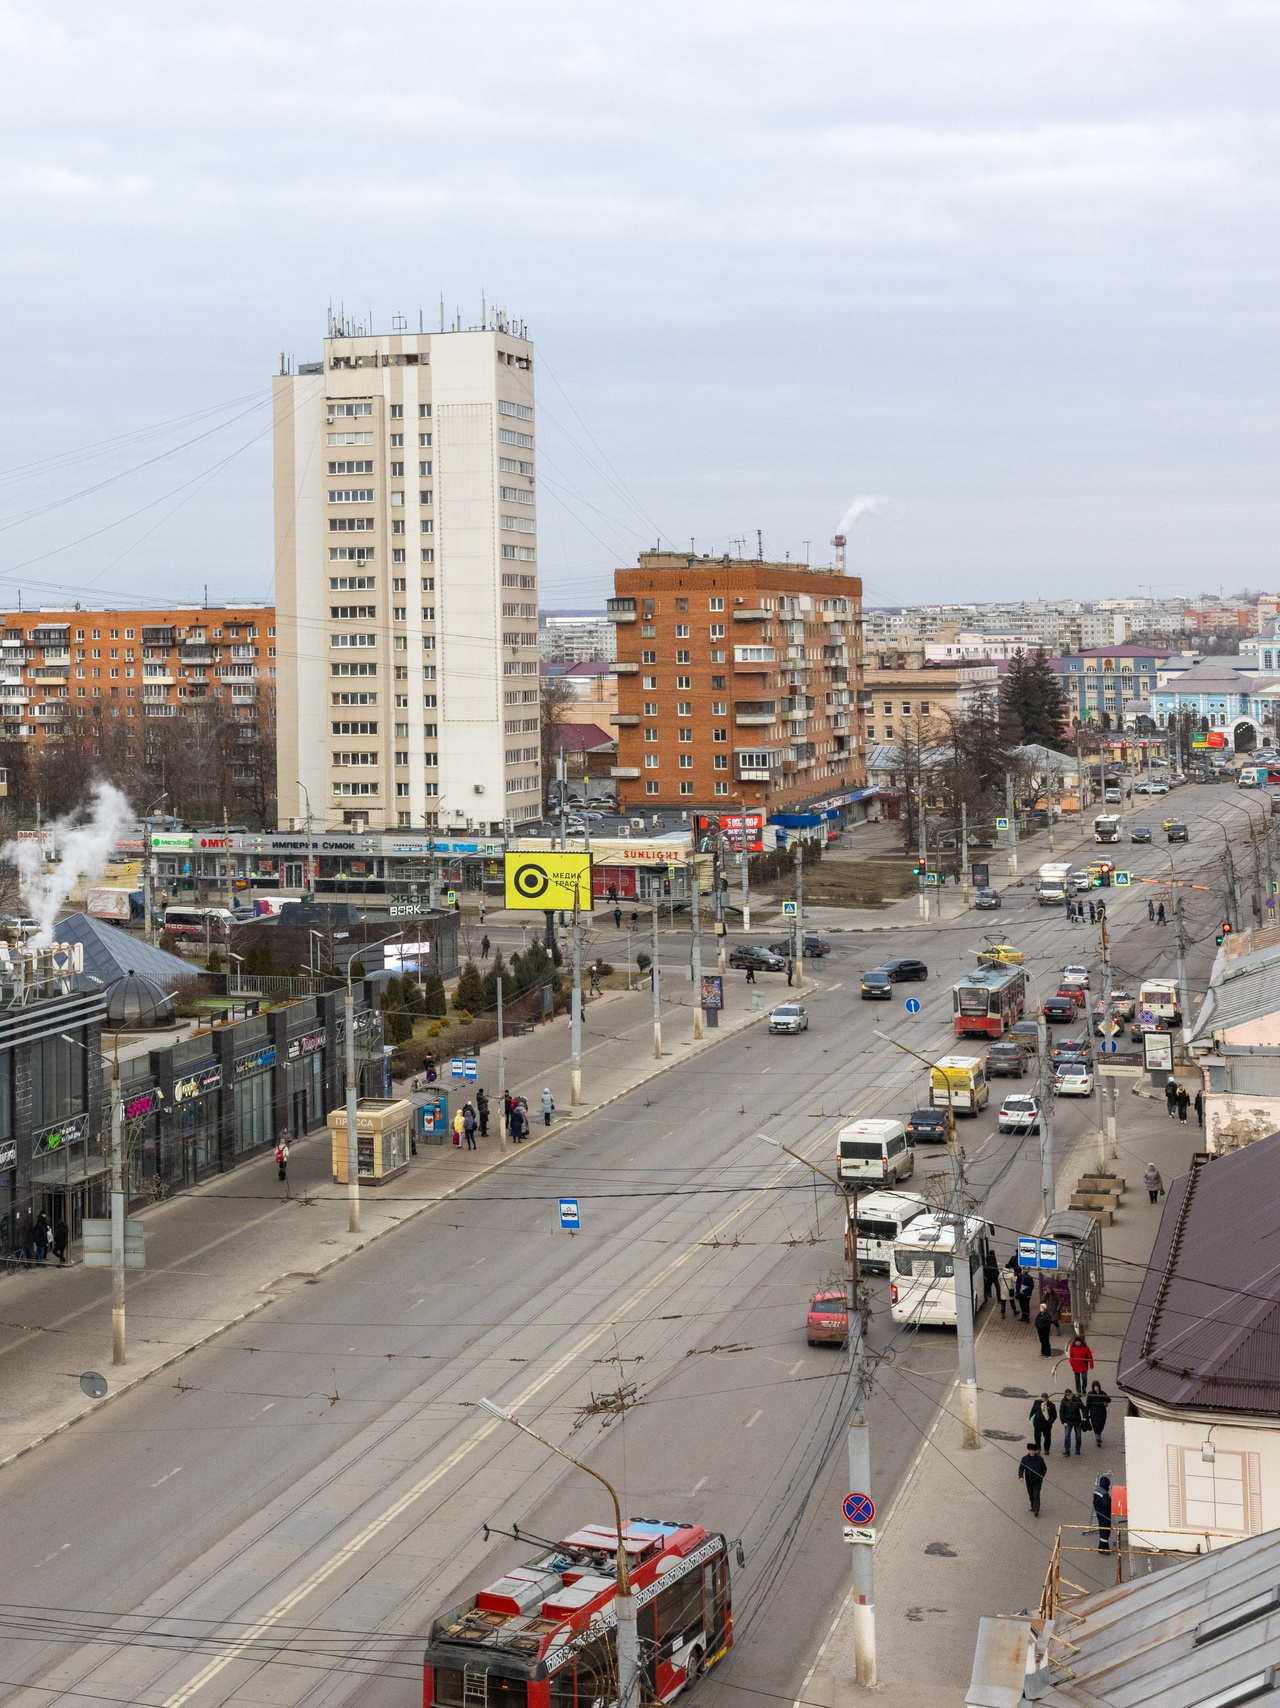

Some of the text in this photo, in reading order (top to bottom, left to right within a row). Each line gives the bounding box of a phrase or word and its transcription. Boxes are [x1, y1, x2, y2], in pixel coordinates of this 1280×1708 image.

[624, 850, 679, 859] SUNLIGHT
[389, 905, 422, 916] BORK
[335, 1117, 373, 1127] ПРССА
